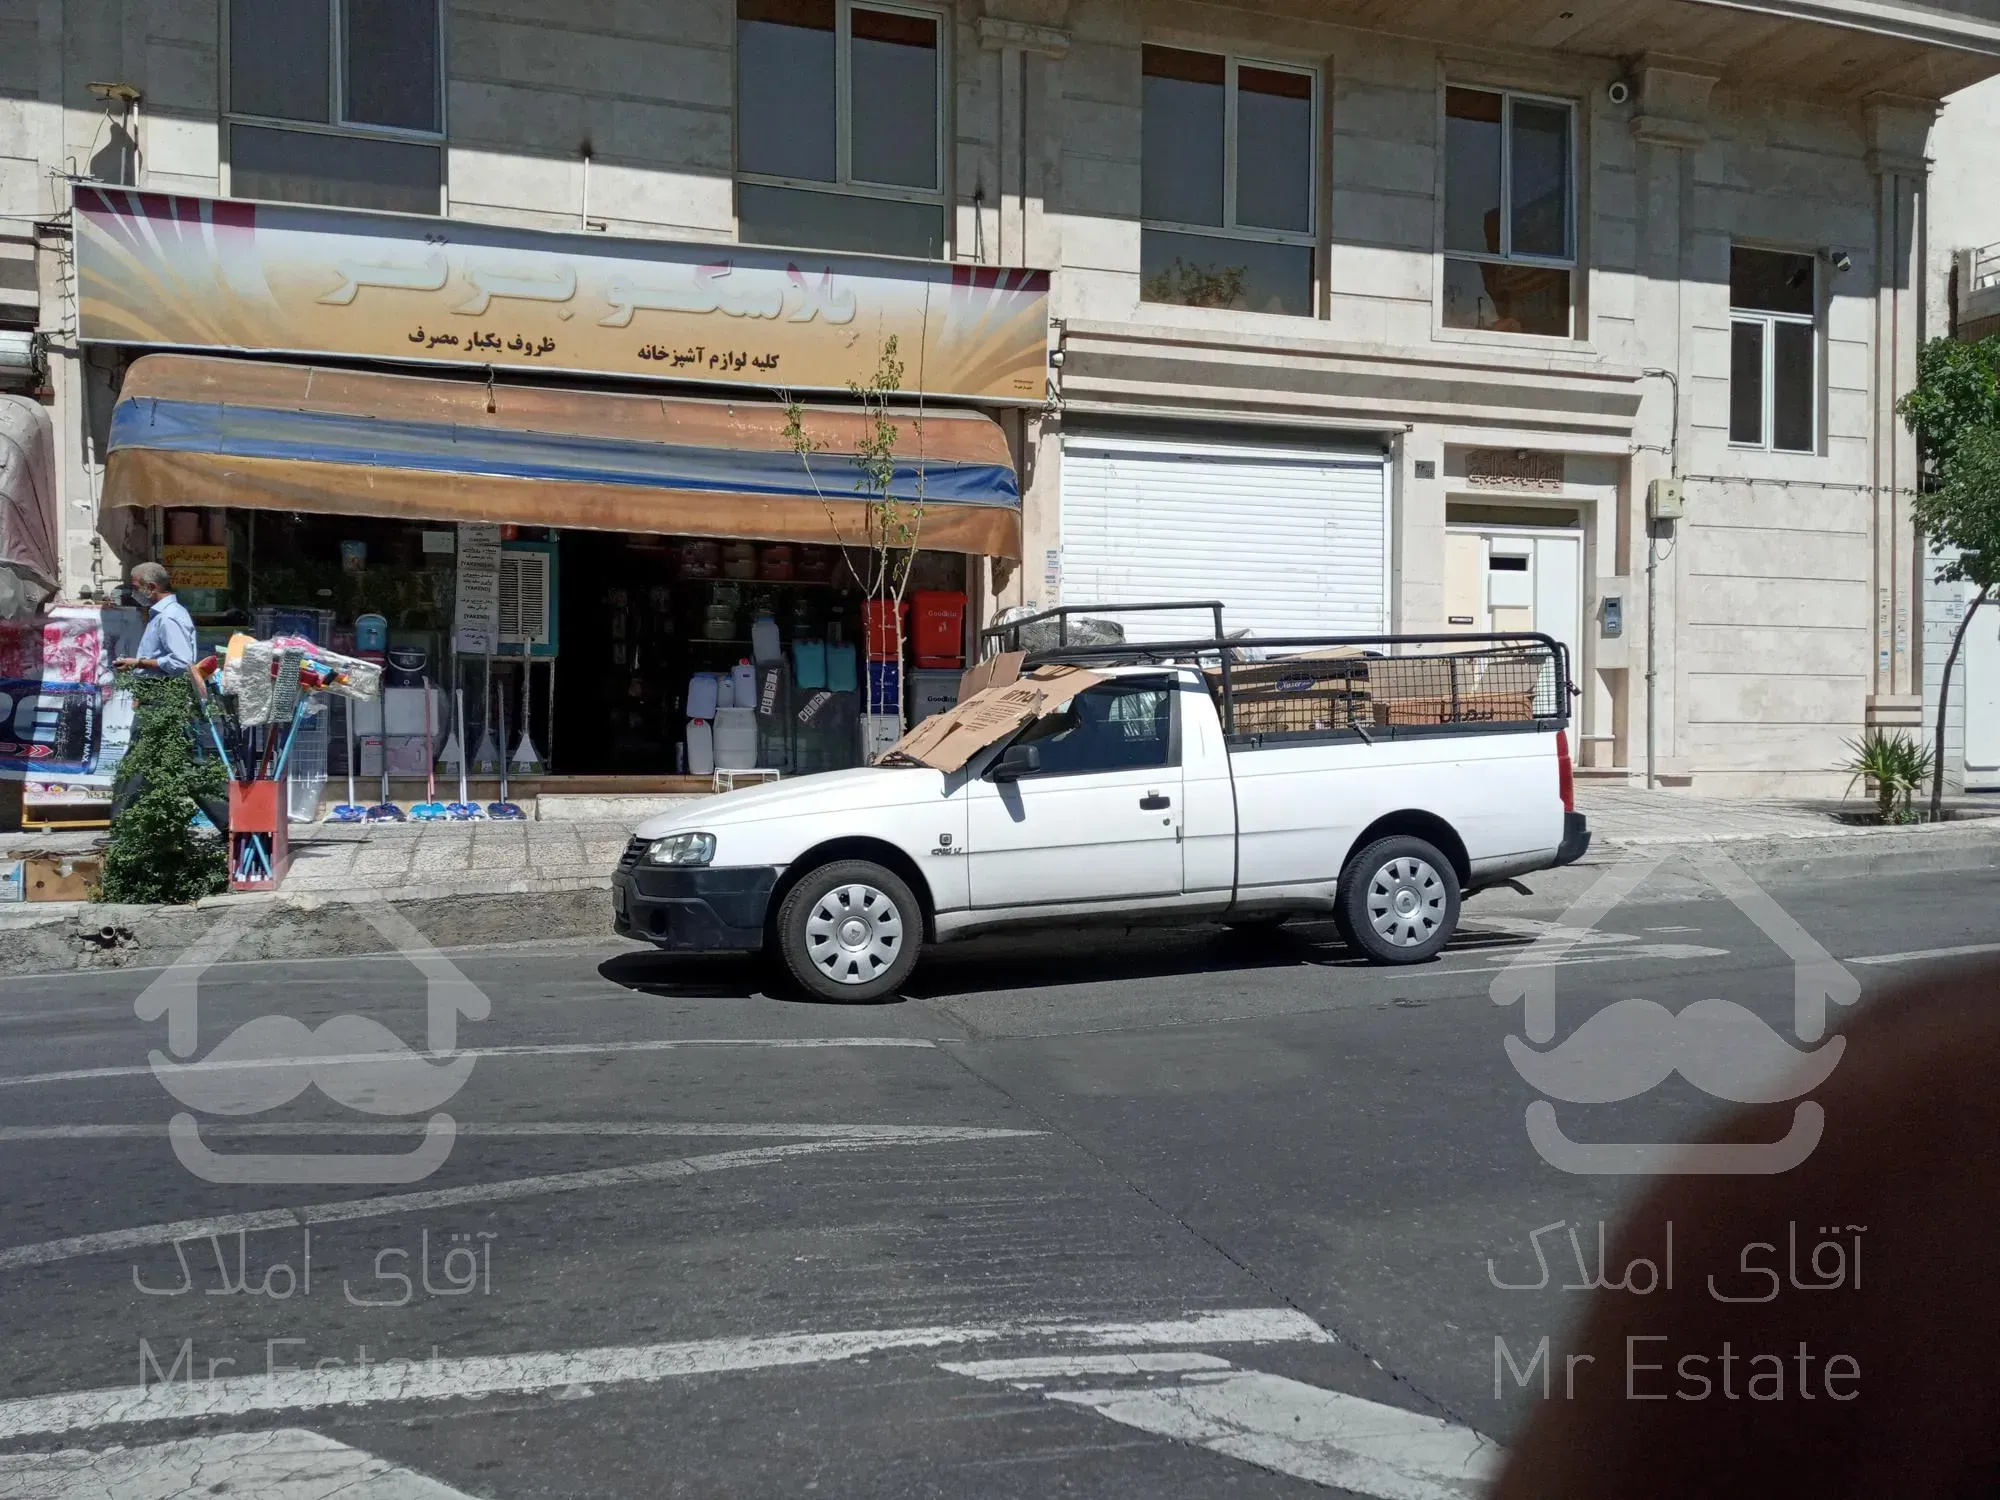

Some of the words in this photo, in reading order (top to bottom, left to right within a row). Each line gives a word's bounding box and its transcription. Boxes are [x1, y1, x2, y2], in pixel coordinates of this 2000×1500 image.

[313, 231, 577, 318] برتر
[597, 259, 859, 349] پلاسکو
[408, 325, 459, 349] مصرف
[463, 331, 502, 353] یکبار
[507, 336, 556, 357] ظروف
[709, 352, 747, 372] لوازم
[751, 353, 780, 373] کلیه
[82, 743, 92, 762] MAX
